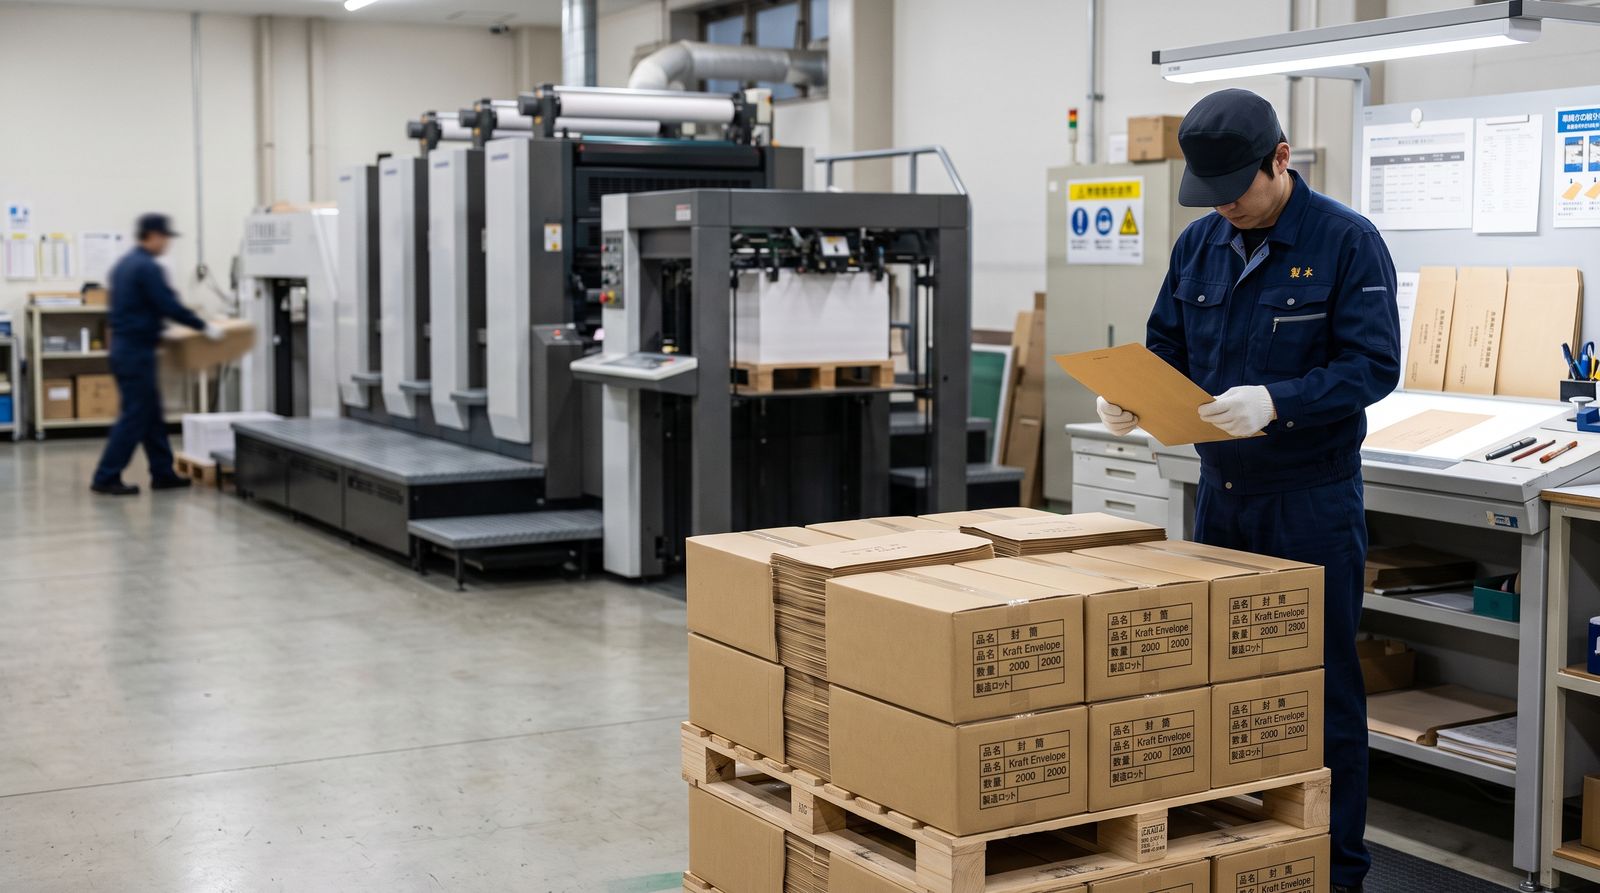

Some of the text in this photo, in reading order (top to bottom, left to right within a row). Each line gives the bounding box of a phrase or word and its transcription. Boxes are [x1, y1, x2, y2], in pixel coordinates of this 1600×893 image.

[1232, 599, 1248, 610] 品名
[1232, 614, 1248, 625] 品名
[1255, 608, 1305, 621] Kraft Envelope
[1111, 615, 1128, 626] 品名
[1111, 630, 1128, 642] 品名
[1135, 624, 1189, 638] Kraft Envelope
[1260, 625, 1278, 636] 2000
[976, 633, 994, 645] 品名
[1170, 638, 1190, 648] 2000
[1002, 641, 1061, 656] Kraft Envelope
[1141, 642, 1160, 653] 2000
[976, 649, 995, 661] 品名
[1009, 660, 1030, 672] 2000
[1041, 656, 1061, 667] 2000
[1232, 704, 1248, 716] 品名
[1232, 719, 1248, 730] 品名
[1254, 711, 1305, 727] Kraft Envelope
[1113, 725, 1130, 736] 品名
[1260, 729, 1279, 740] 2000
[1288, 724, 1305, 735] 2000
[1137, 732, 1191, 747] Kraft Envelope
[983, 745, 1001, 757] 品名
[1113, 740, 1130, 752] 品名
[1172, 745, 1191, 756] 2000
[1009, 752, 1066, 769] Kraft Envelope
[1143, 751, 1163, 762] 2000
[983, 761, 1001, 773] 品名
[1047, 766, 1067, 777] 2000
[1015, 772, 1036, 783] 2000
[1281, 877, 1311, 890] Envelope
